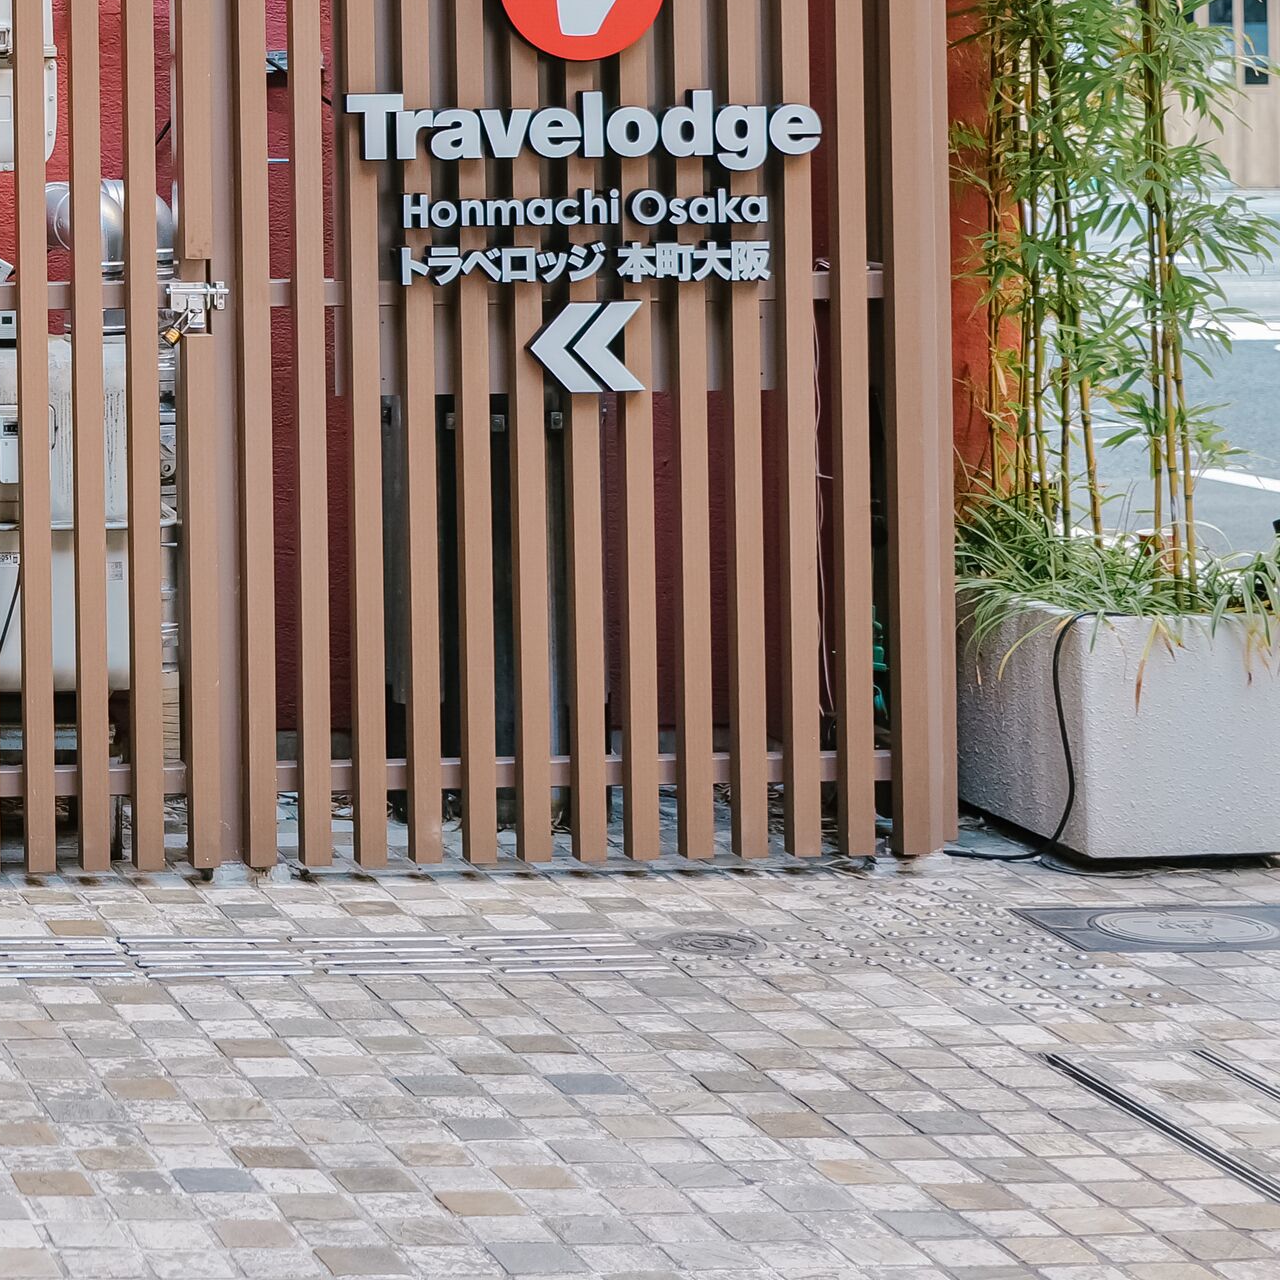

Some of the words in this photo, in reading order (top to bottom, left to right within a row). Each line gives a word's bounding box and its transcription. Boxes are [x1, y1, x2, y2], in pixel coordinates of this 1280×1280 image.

[344, 89, 822, 171] Travelodge
[402, 188, 620, 229] Honmachi
[631, 188, 769, 225] Osaka
[400, 241, 606, 286] トラベロッジ
[617, 240, 771, 283] 本町大阪
